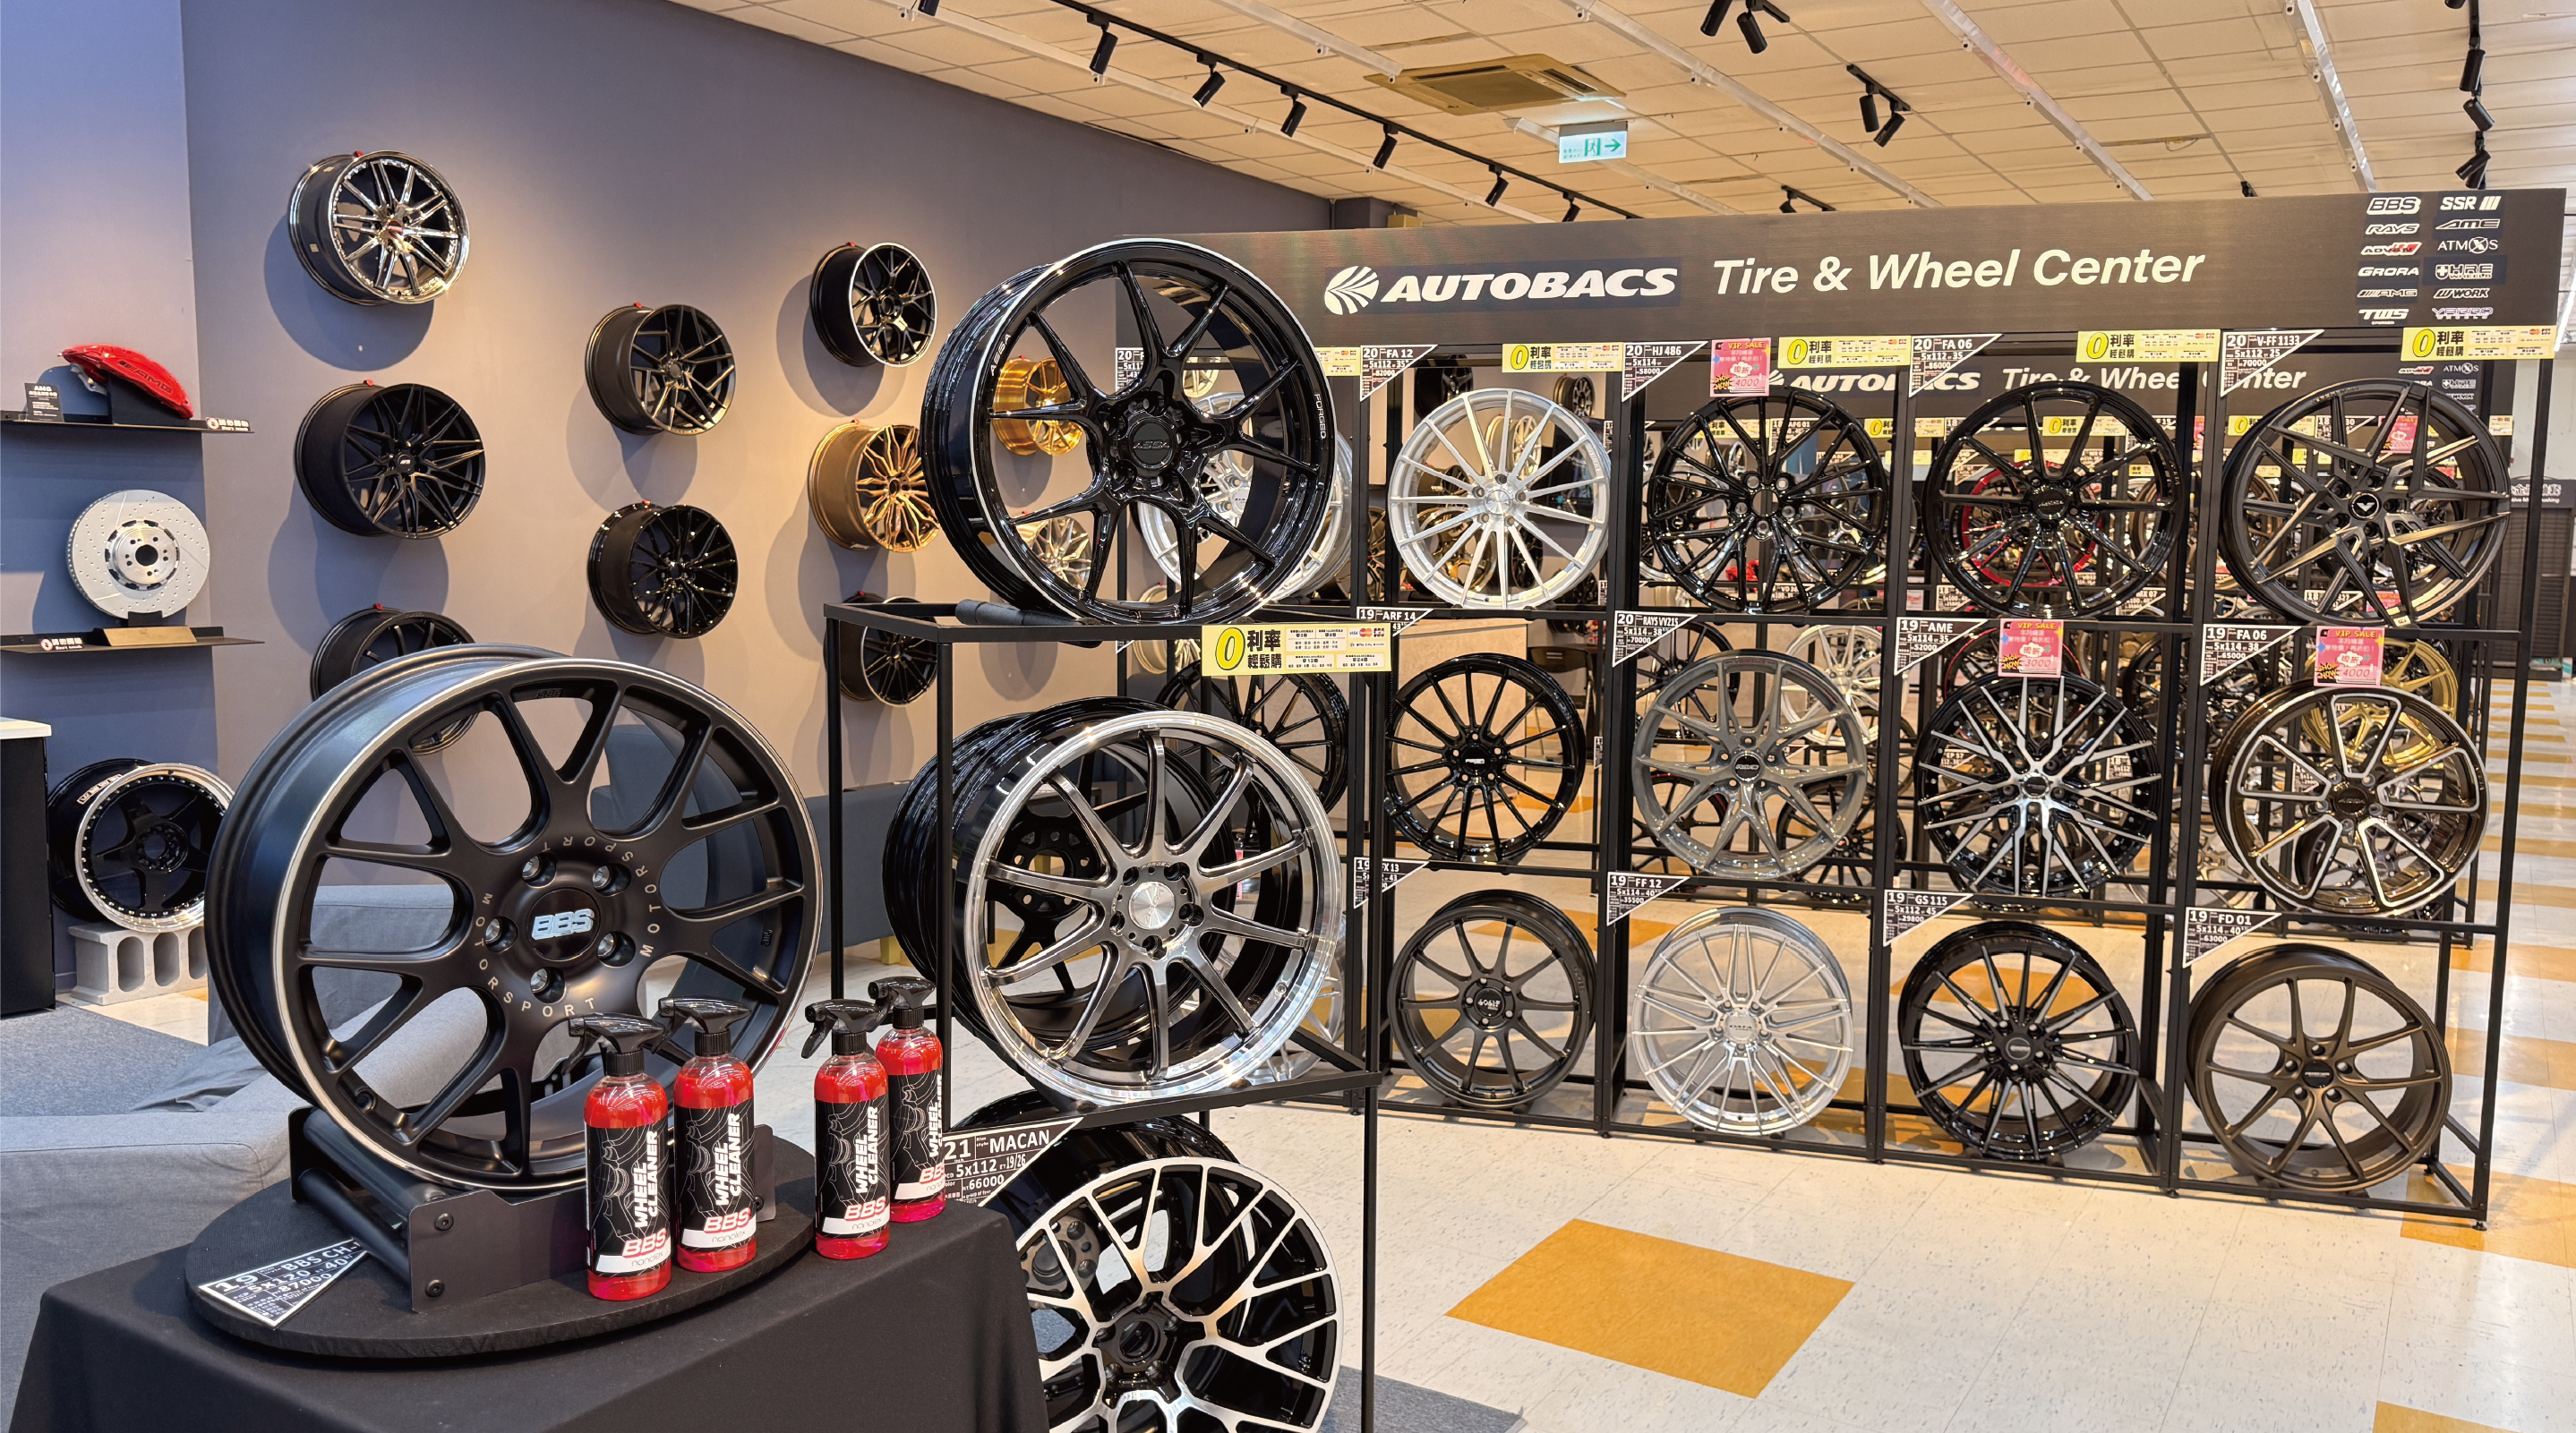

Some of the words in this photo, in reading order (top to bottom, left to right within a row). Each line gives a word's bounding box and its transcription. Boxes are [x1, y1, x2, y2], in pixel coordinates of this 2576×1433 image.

[2366, 196, 2421, 215] BBS
[2440, 196, 2478, 210] SSR
[2366, 224, 2419, 235] RAYS
[2435, 219, 2500, 230] AME
[1714, 258, 1798, 294] Tire
[1813, 255, 1853, 292] &
[1869, 249, 2022, 291] Wheel
[2033, 250, 2206, 286] Center
[2358, 267, 2419, 277] GRORA
[2449, 263, 2493, 274] HRE
[1380, 268, 1678, 303] AUTOBACS
[2376, 289, 2418, 298] AMG
[2452, 288, 2490, 298] WORK
[2358, 309, 2409, 320] TWS
[1913, 338, 1932, 350] 20
[1942, 339, 1956, 350] FA
[1957, 338, 1973, 349] 06
[2110, 334, 2135, 347] 利率
[2227, 336, 2247, 346] 20
[2257, 336, 2277, 346] V-FF
[2278, 335, 2300, 346] 1133
[2412, 328, 2435, 357] 0
[2436, 331, 2464, 345] 利率
[1530, 346, 1552, 359] 利率
[1626, 345, 1643, 356] 20
[1652, 345, 1664, 356] HJ
[1665, 345, 1682, 356] 486
[1787, 338, 1808, 364] 0
[1809, 340, 1832, 354] 利率
[2086, 332, 2109, 359] 0
[1118, 351, 1133, 360] 20
[1363, 348, 1379, 359] 20
[1387, 350, 1399, 358] FA
[1400, 349, 1414, 358] 12
[1511, 345, 1529, 370] 0
[1921, 352, 1947, 361] 5x112
[1952, 352, 1964, 360] 35
[2235, 349, 2263, 358] 5x112
[2269, 349, 2281, 357] 25
[1369, 360, 1391, 368] 5x112
[1632, 358, 1656, 367] 5x114
[2242, 359, 2267, 367] 70000
[1735, 378, 1759, 387] 4000
[2101, 367, 2180, 389] Whee
[1314, 394, 1327, 439] FORGED
[1360, 609, 1374, 619] 19
[1382, 611, 1402, 620] ARF
[1404, 611, 1416, 621] 14
[1617, 614, 1634, 625] 20
[1642, 616, 1658, 626] RAYS
[1623, 627, 1647, 635] 5x114
[1653, 627, 1663, 635] 38
[1901, 620, 1918, 631] 19
[1928, 623, 1953, 634] AME
[2206, 627, 2226, 639] 19
[2236, 629, 2250, 640] FA
[2253, 629, 2267, 641] 06
[2354, 630, 2376, 638] SALE
[1246, 628, 1281, 652] 利率
[1907, 634, 1933, 643] 5x114
[1939, 635, 1949, 644] 35
[1215, 627, 1245, 670] 0
[2213, 642, 2242, 651] 5x114
[2247, 643, 2259, 652] 38
[1246, 653, 1282, 670] 輕鬆購
[2024, 659, 2050, 668] 3000
[2343, 669, 2370, 678] 4000
[1391, 864, 1399, 873] 13
[1611, 875, 1627, 886] 19
[1635, 878, 1647, 888] FF
[1648, 879, 1662, 888] 12
[1617, 888, 1640, 896] 5x114
[1887, 892, 1905, 902] 19
[1914, 895, 1929, 905] GS
[1930, 896, 1947, 906] 115
[531, 908, 595, 941] BBS
[2189, 911, 2208, 922] 19
[2219, 914, 2235, 924] FD
[2237, 915, 2252, 925] 01
[2196, 925, 2224, 934] 5x114
[2229, 926, 2241, 934] 40
[2204, 934, 2228, 943] 63000
[475, 892, 595, 1019] MOTORSPORT
[929, 1101, 939, 1158] WHEEL
[867, 1106, 878, 1185] CLEANER
[944, 1139, 971, 1160] 21
[989, 1130, 1050, 1154] MACAN
[727, 1113, 741, 1197] CLEANER
[856, 1134, 868, 1194] WHEEL
[956, 1159, 997, 1178] 5x112
[1006, 1153, 1026, 1170] 19/26
[646, 1130, 658, 1217] CLEANER
[715, 1142, 730, 1206] WHEEL
[969, 1174, 1005, 1190] 66000
[634, 1163, 648, 1228] WHEEL
[844, 1196, 886, 1222] BBS
[704, 1207, 751, 1233] BBS
[621, 1227, 667, 1258] BBS
[216, 1275, 259, 1292] 19
[280, 1256, 322, 1272] BBS
[247, 1269, 312, 1292] 5x120
[325, 1258, 348, 1270] 40
[278, 1273, 332, 1292] 87000
